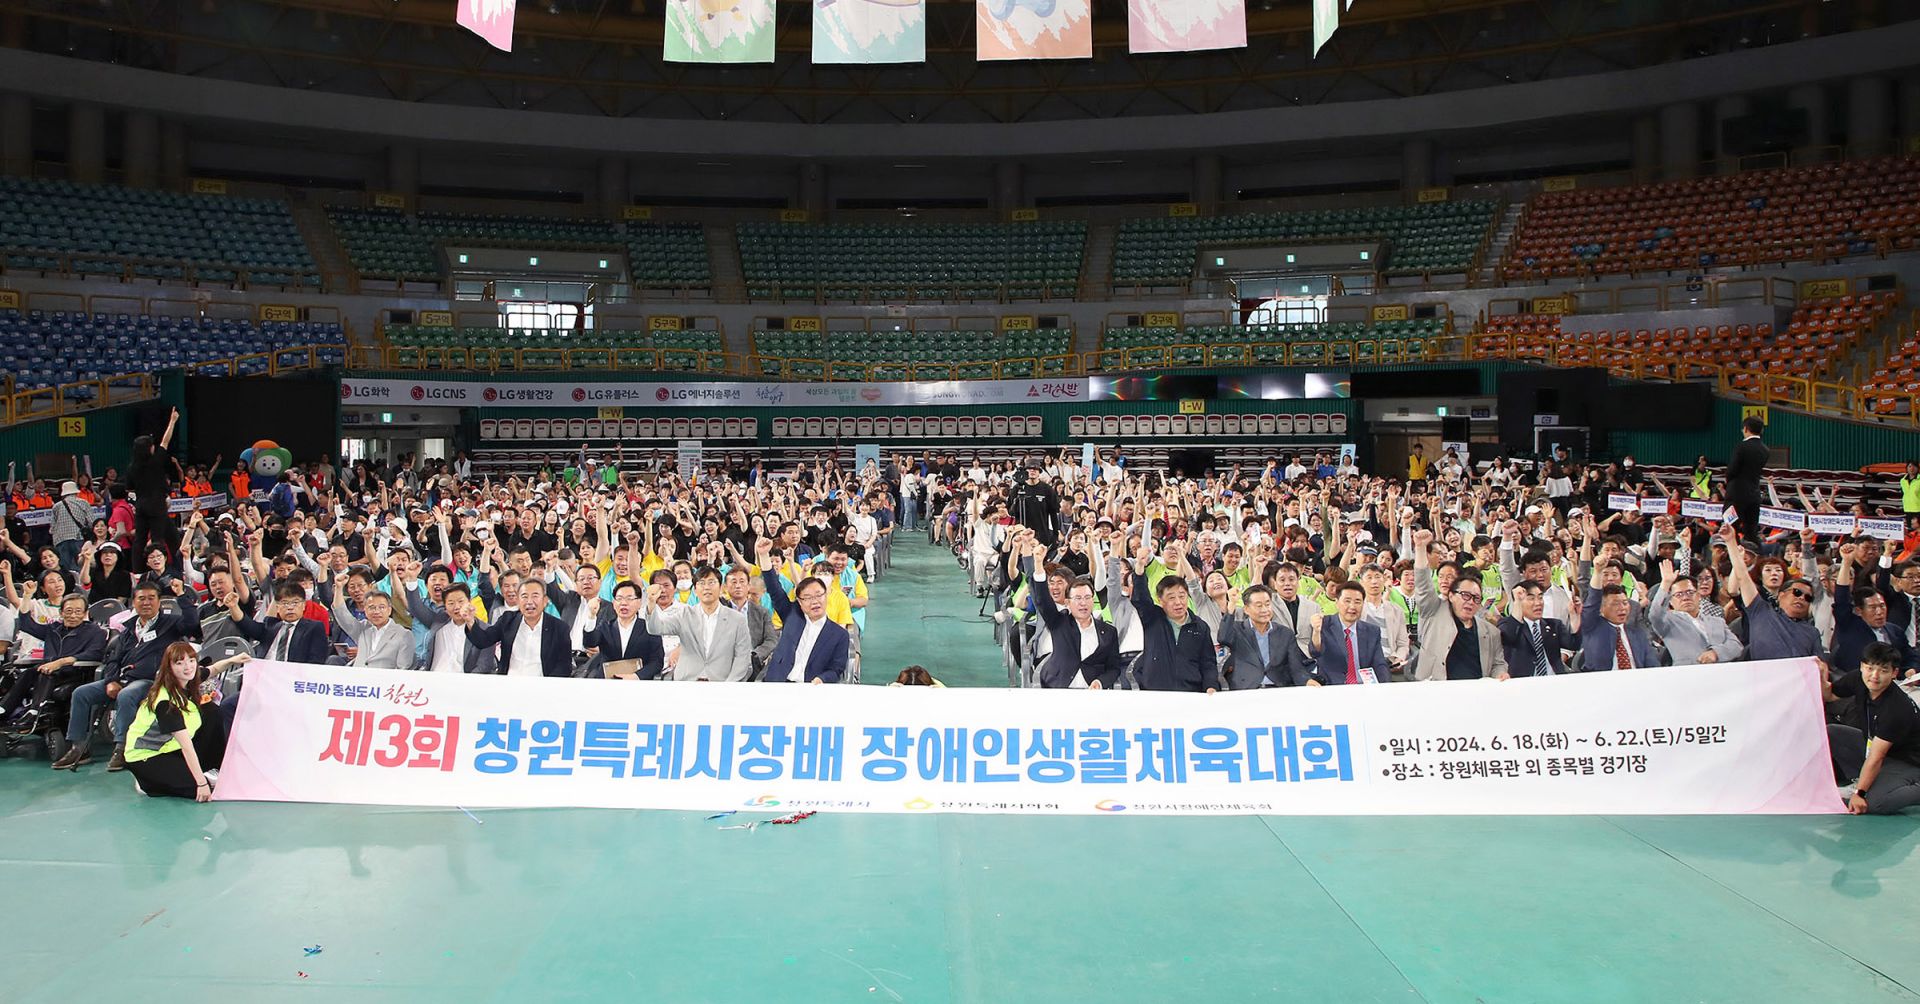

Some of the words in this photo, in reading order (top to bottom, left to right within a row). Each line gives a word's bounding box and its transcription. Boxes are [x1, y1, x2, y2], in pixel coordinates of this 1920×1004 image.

[1810, 282, 1840, 297] 2구역
[265, 307, 293, 320] 6구역
[425, 312, 450, 325] 5구역
[1377, 308, 1402, 319] 3구역
[653, 317, 677, 329] 5구역
[793, 318, 817, 330] 4구역
[1005, 318, 1029, 330] 4구역
[1150, 314, 1173, 326] 3구역
[354, 386, 390, 397] LG화학
[499, 389, 554, 400] LG생활건강
[588, 389, 640, 400] LG유플러스
[671, 389, 741, 400] LG에너지솔루션
[600, 408, 621, 418] 1-W
[1182, 402, 1202, 412] 1-W
[63, 420, 83, 434] 1-S
[293, 680, 331, 696] 동북아
[332, 683, 381, 700] 중심도시
[382, 683, 430, 708] 창원
[318, 708, 460, 773] 제3회
[473, 717, 845, 782] 창원특례시장배
[861, 724, 1354, 784] 장애인생활체육대회
[1389, 738, 1421, 756] 일시
[1436, 736, 1486, 753] 2024.
[1490, 735, 1509, 752] 6.
[1512, 732, 1570, 752] 18.(화)
[1594, 731, 1612, 747] 6.
[1616, 725, 1728, 747] 22.(토)/5일간
[1391, 761, 1424, 780] 장소
[1438, 759, 1520, 781] 창원체육관
[1525, 758, 1542, 776] 외
[1546, 756, 1596, 776] 종목별
[1600, 754, 1648, 775] 경기장
[1133, 803, 1273, 812] 창원시장애인체육회
